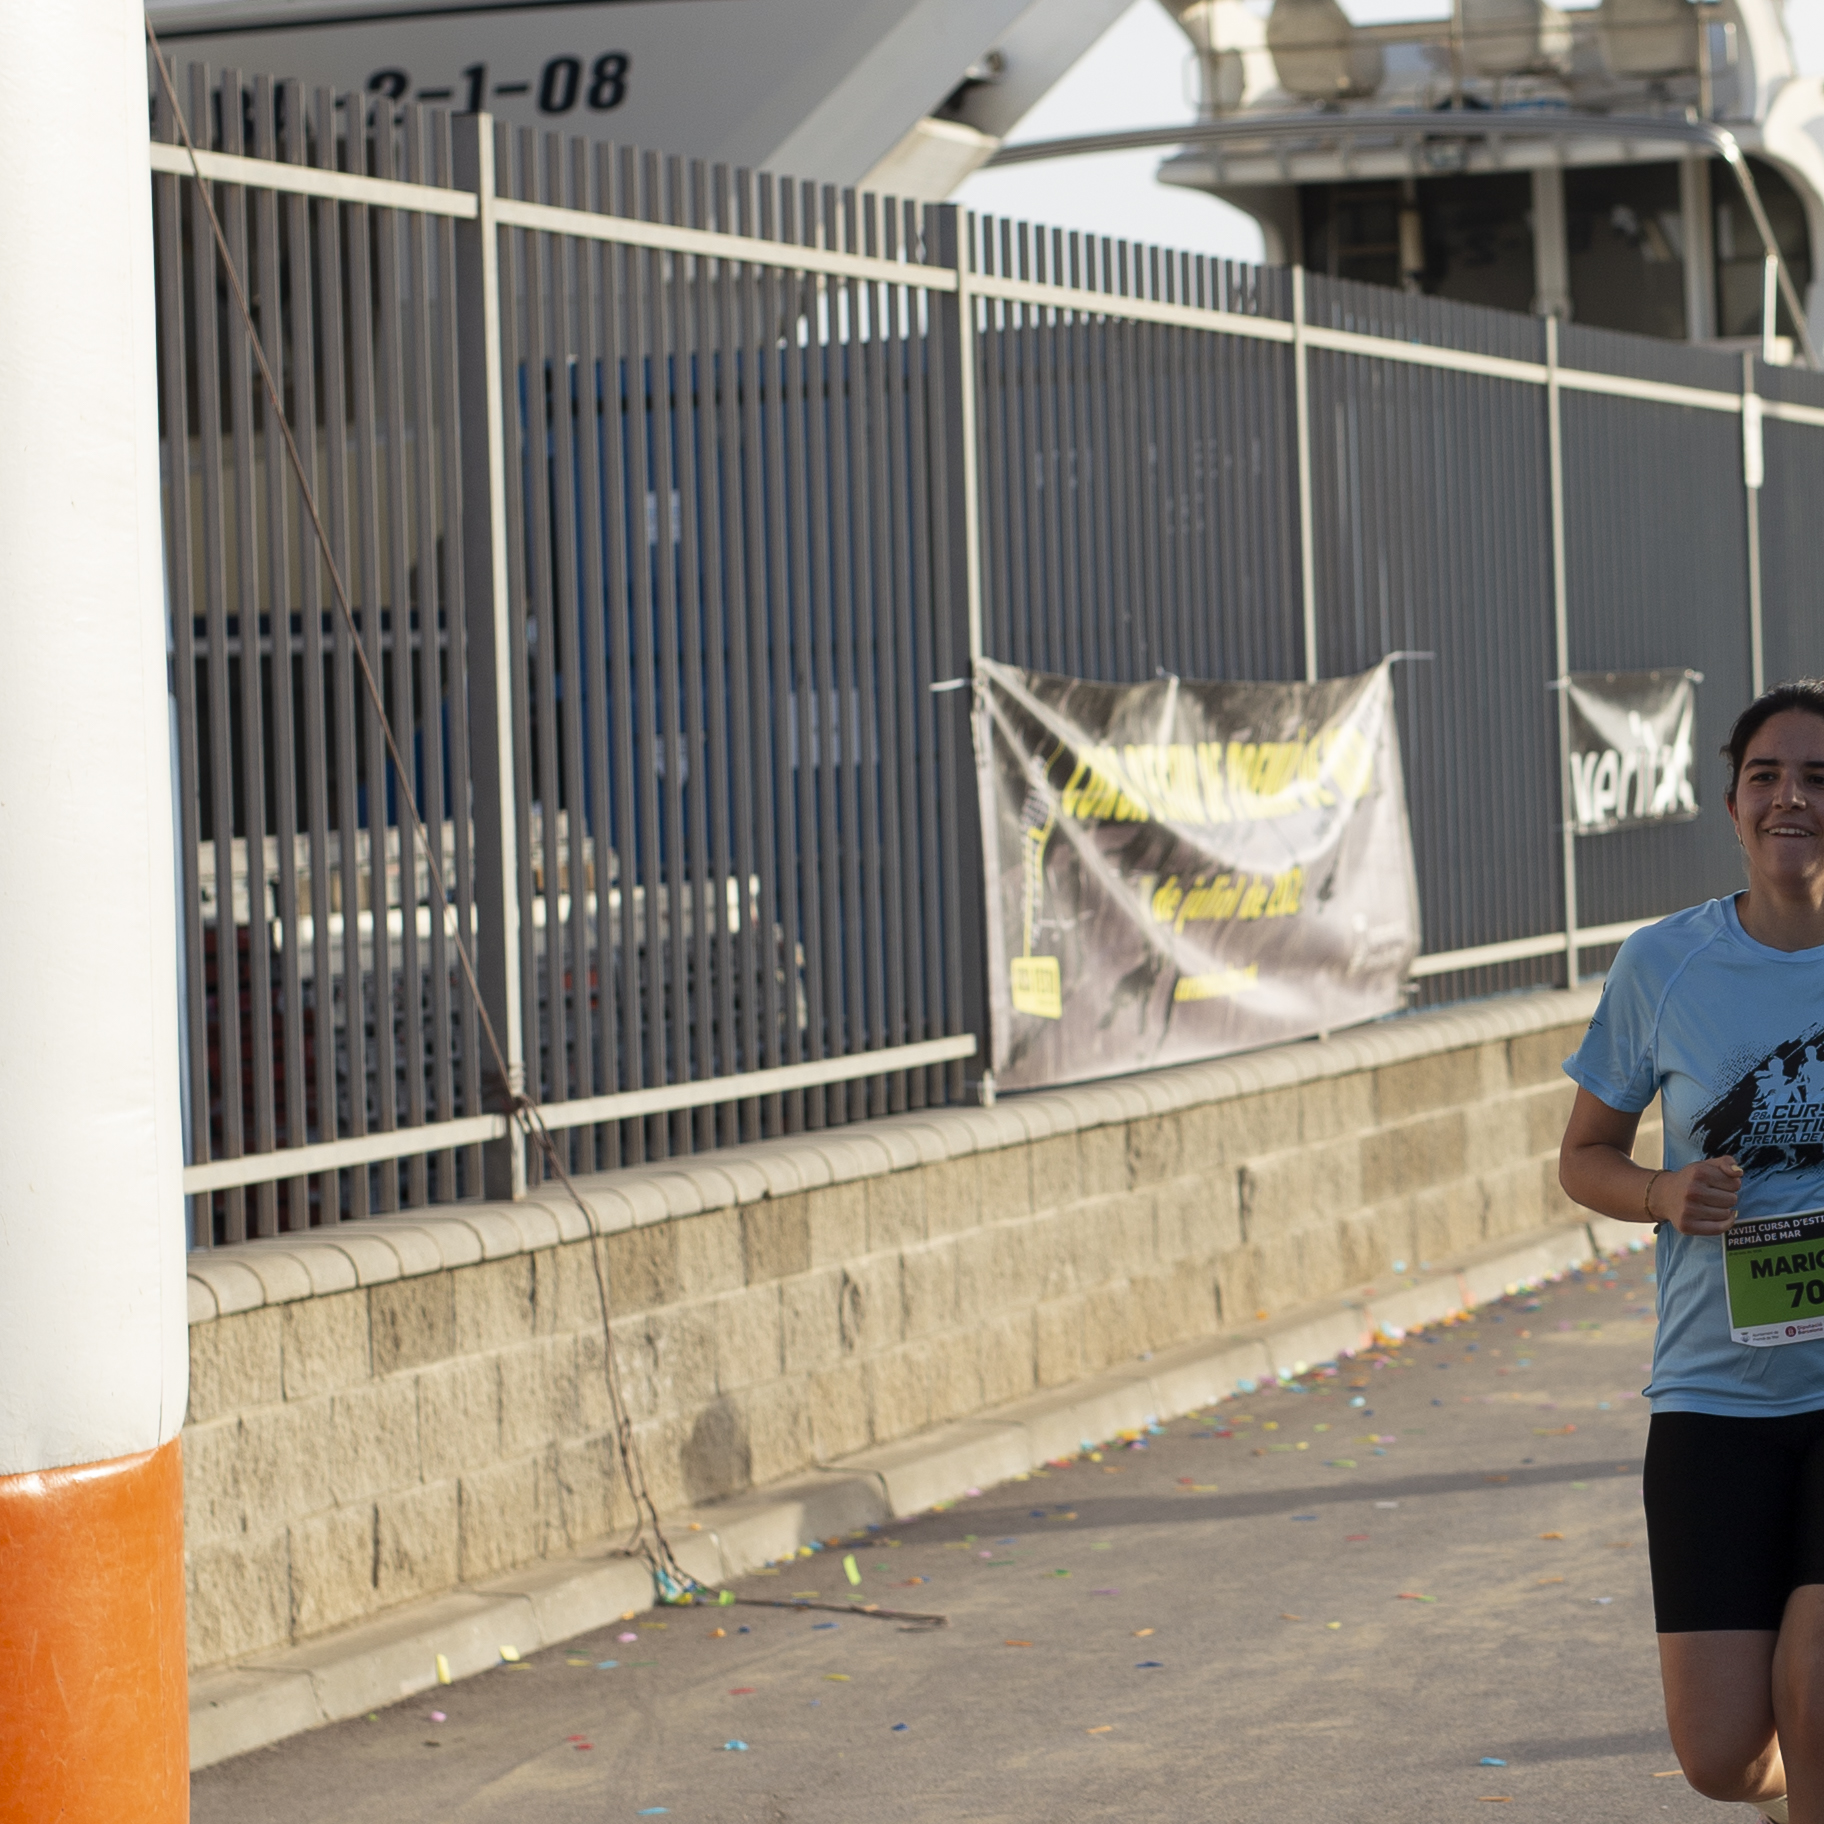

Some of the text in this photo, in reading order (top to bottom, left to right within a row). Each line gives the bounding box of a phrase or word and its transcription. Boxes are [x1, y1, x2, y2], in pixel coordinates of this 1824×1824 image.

[1799, 1132, 1820, 1142] DE
[1727, 1224, 1757, 1236] XXVIII
[1758, 1221, 1791, 1232] CURSA
[1728, 1229, 1802, 1246] PREMIÀ DE MAR
